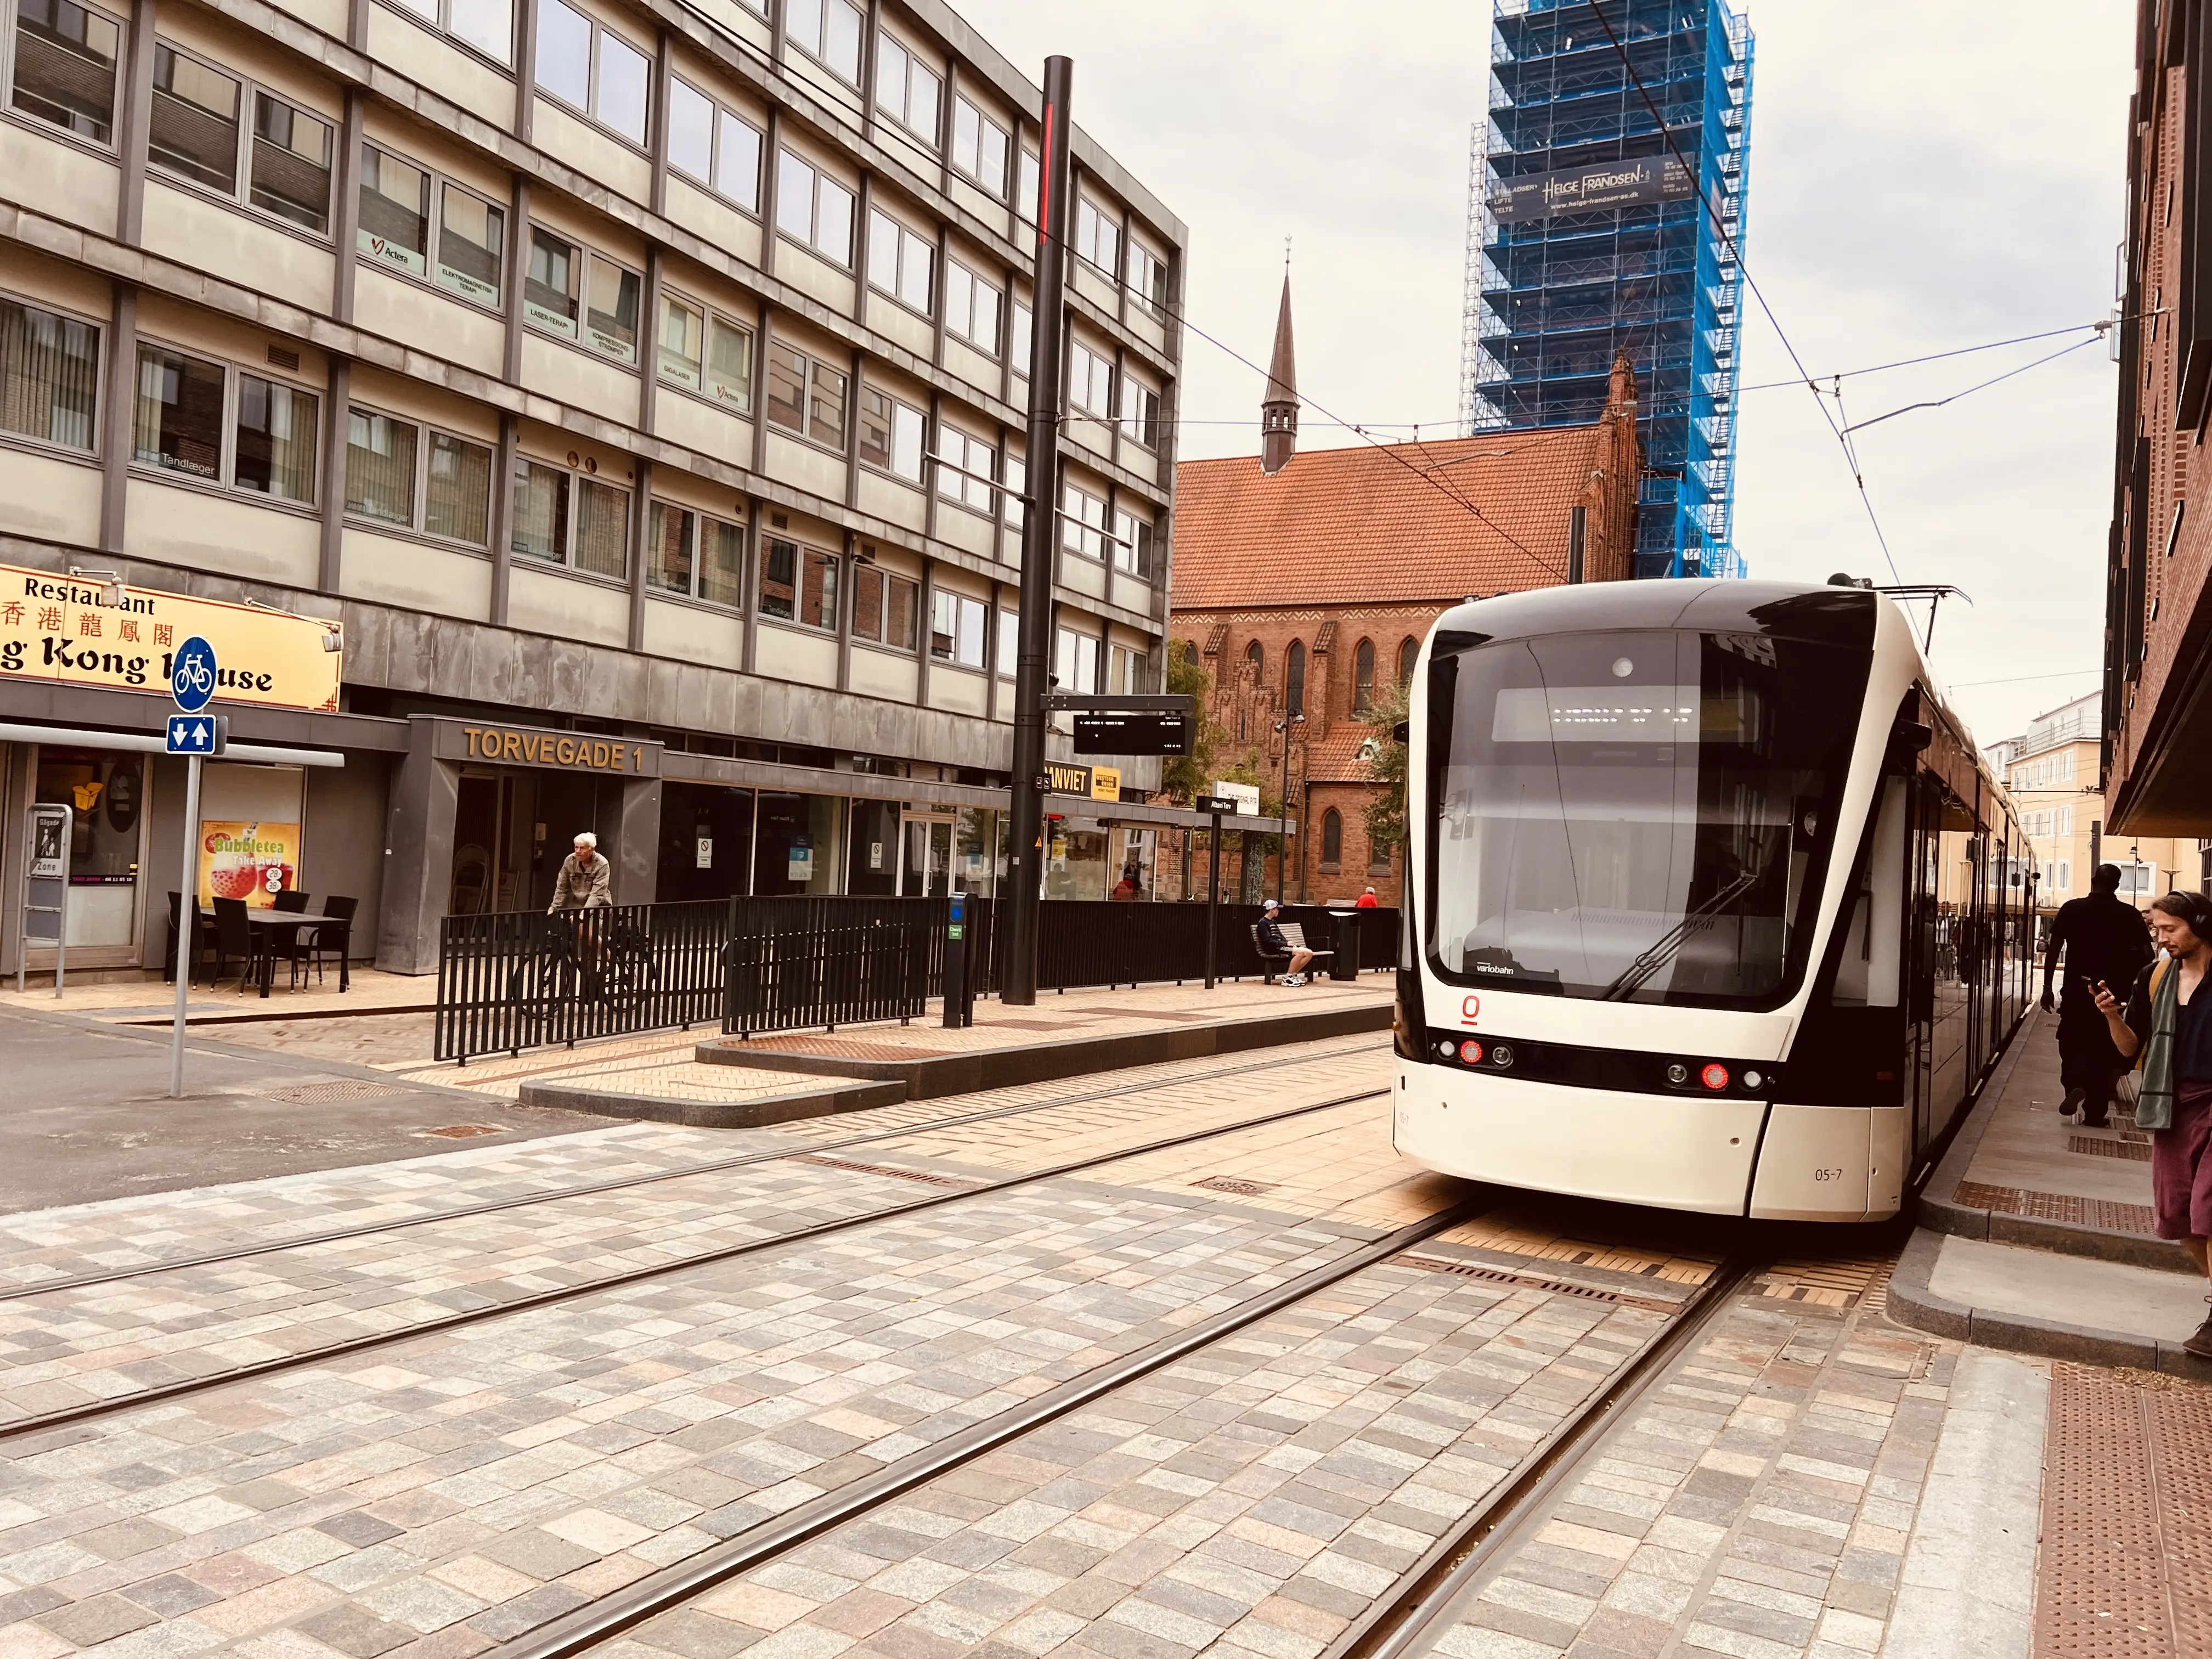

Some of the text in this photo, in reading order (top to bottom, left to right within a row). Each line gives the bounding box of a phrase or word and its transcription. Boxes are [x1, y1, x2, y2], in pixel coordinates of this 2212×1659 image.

[1542, 163, 1640, 204] HELGE FRANDSEN
[386, 247, 408, 263] Actera
[442, 269, 493, 294] ELEKTROMAGNETISK
[459, 283, 477, 294] TERAPI
[531, 308, 568, 329] LASER-TERAPI
[664, 365, 690, 380] GIGALASER
[162, 452, 215, 476] Tandlæger
[25, 578, 155, 615] Restauant
[2, 601, 173, 647] 香港龍鳳閣
[42, 636, 149, 684] Kong
[162, 653, 272, 691] use
[464, 727, 642, 771] TORVEGADE 1
[1045, 766, 1086, 792] ANVIET
[1211, 800, 1223, 809] Albani
[215, 839, 284, 853] Bubbletea
[37, 862, 57, 871] Zone
[233, 855, 283, 867] Take Away
[1477, 964, 1514, 975] variobahn
[1815, 1169, 1842, 1181] 05-7
